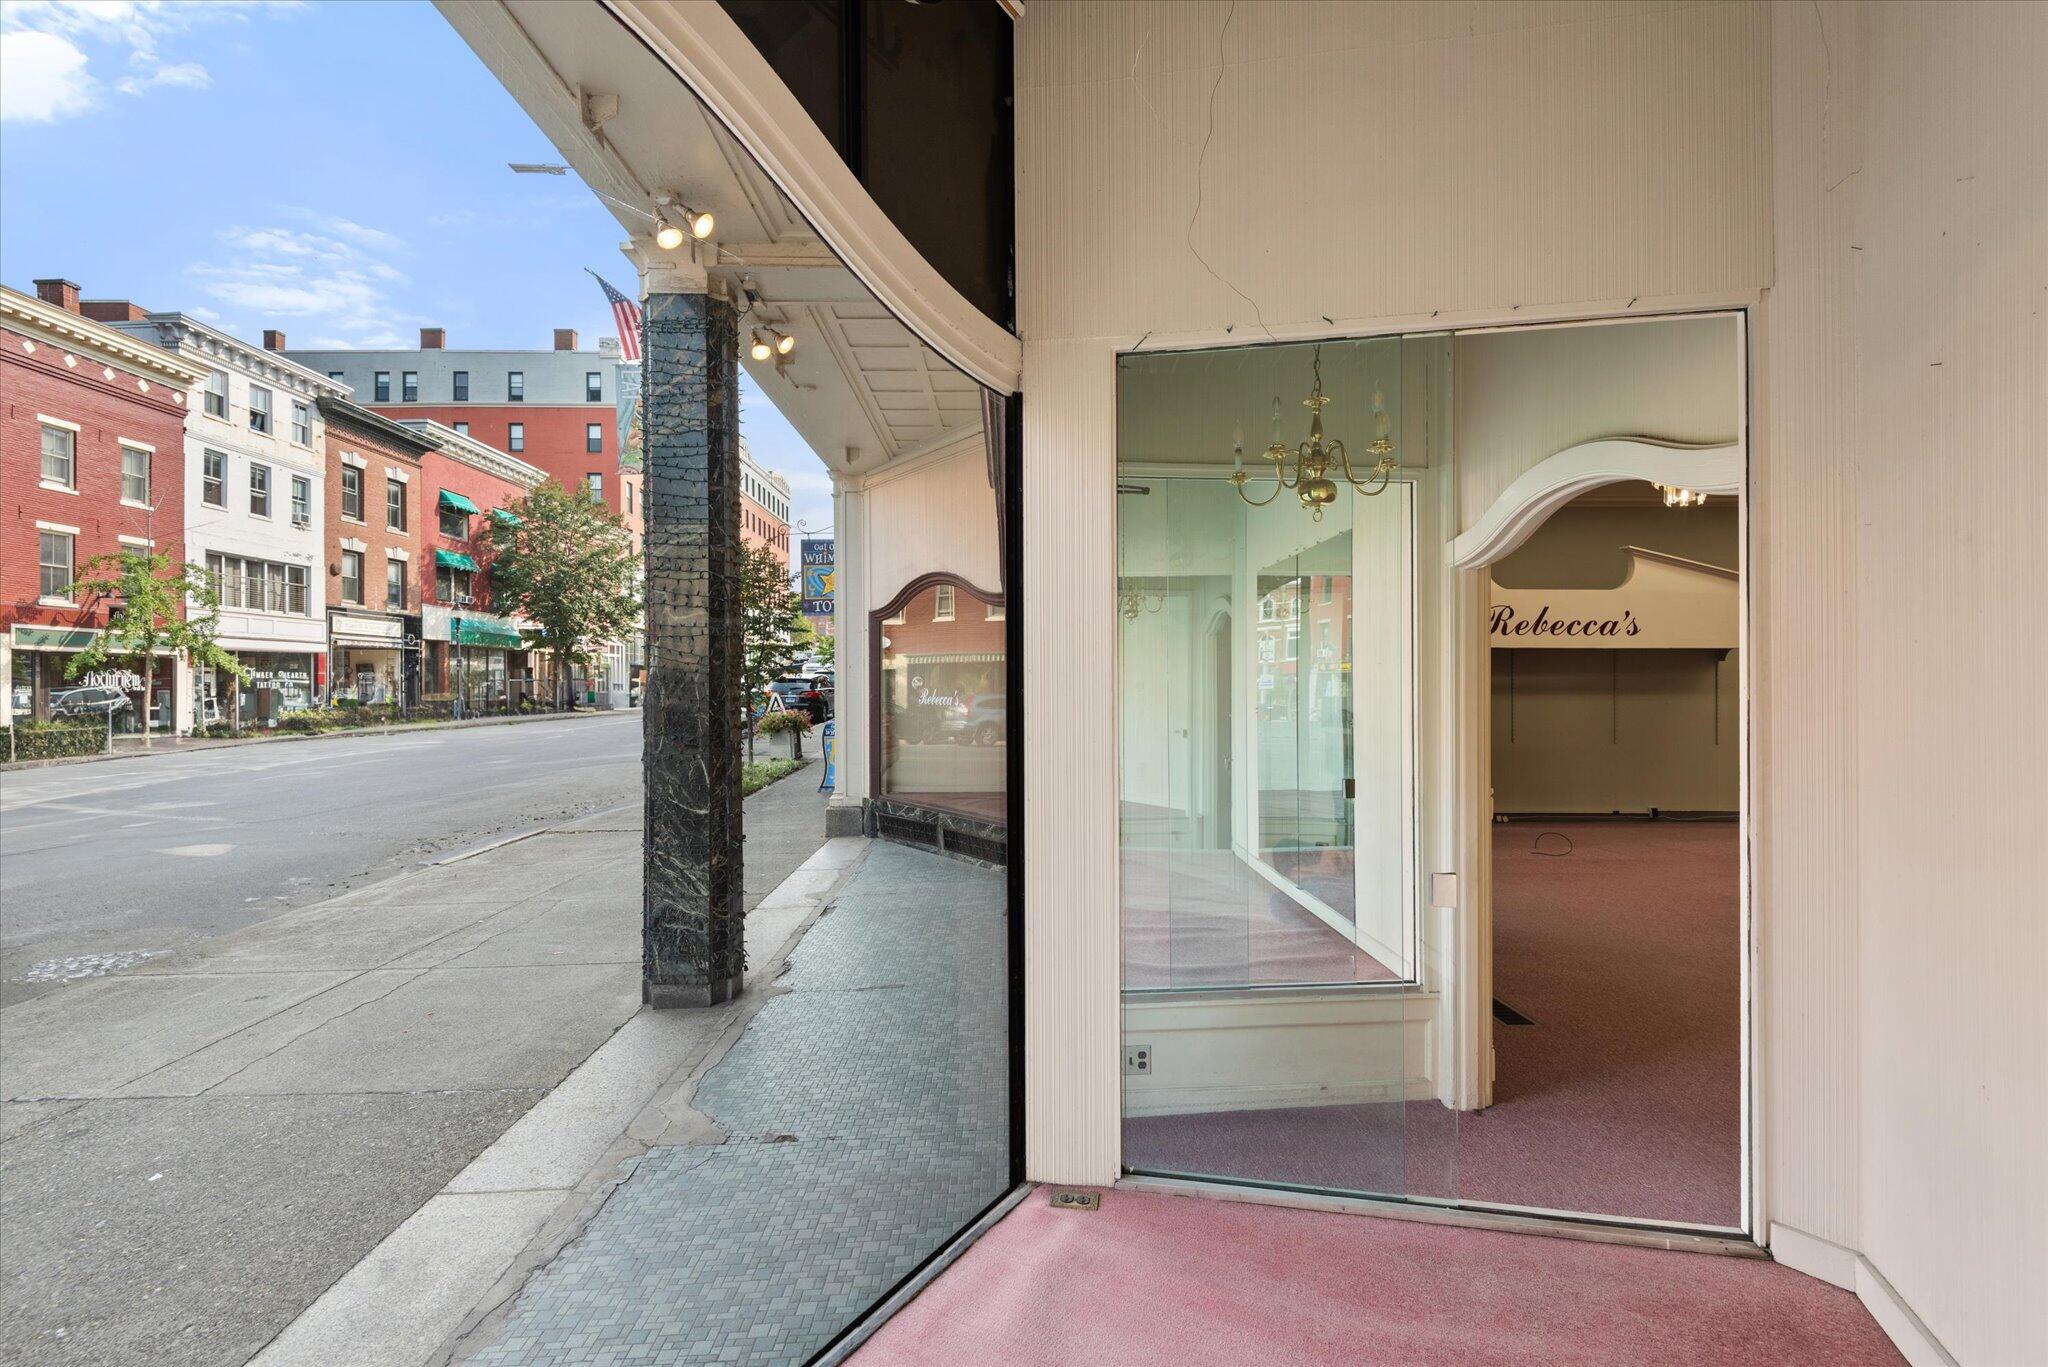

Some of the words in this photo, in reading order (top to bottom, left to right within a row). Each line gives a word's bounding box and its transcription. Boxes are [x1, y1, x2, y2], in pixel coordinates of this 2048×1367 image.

[813, 600, 834, 612] TO
[1490, 604, 1641, 636] Rebecca's
[256, 681, 280, 689] TATTOO
[918, 688, 960, 706] Rebecca's
